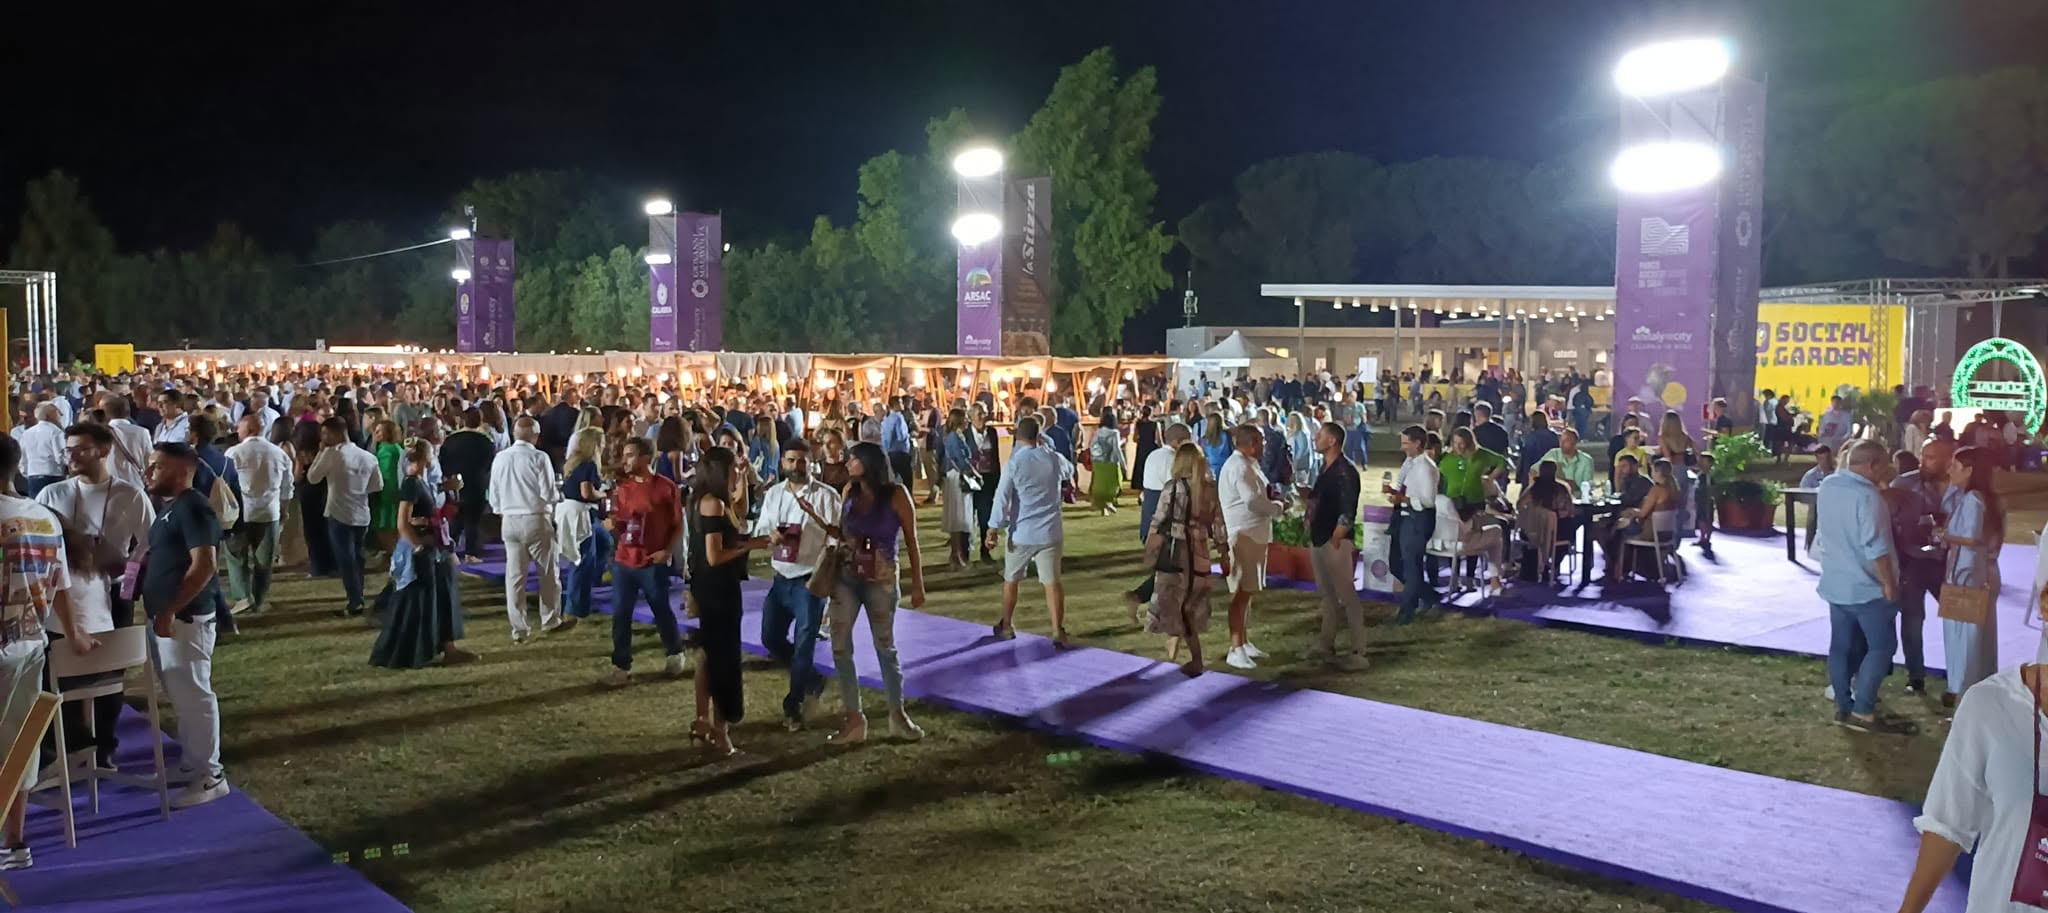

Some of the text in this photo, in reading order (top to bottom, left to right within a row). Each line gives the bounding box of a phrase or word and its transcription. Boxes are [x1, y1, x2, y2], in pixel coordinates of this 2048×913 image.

[1023, 184, 1036, 259] Stizza
[964, 290, 992, 301] ARSAC
[1776, 322, 1874, 343] SOCIAL
[1775, 346, 1873, 367] GARDEN
